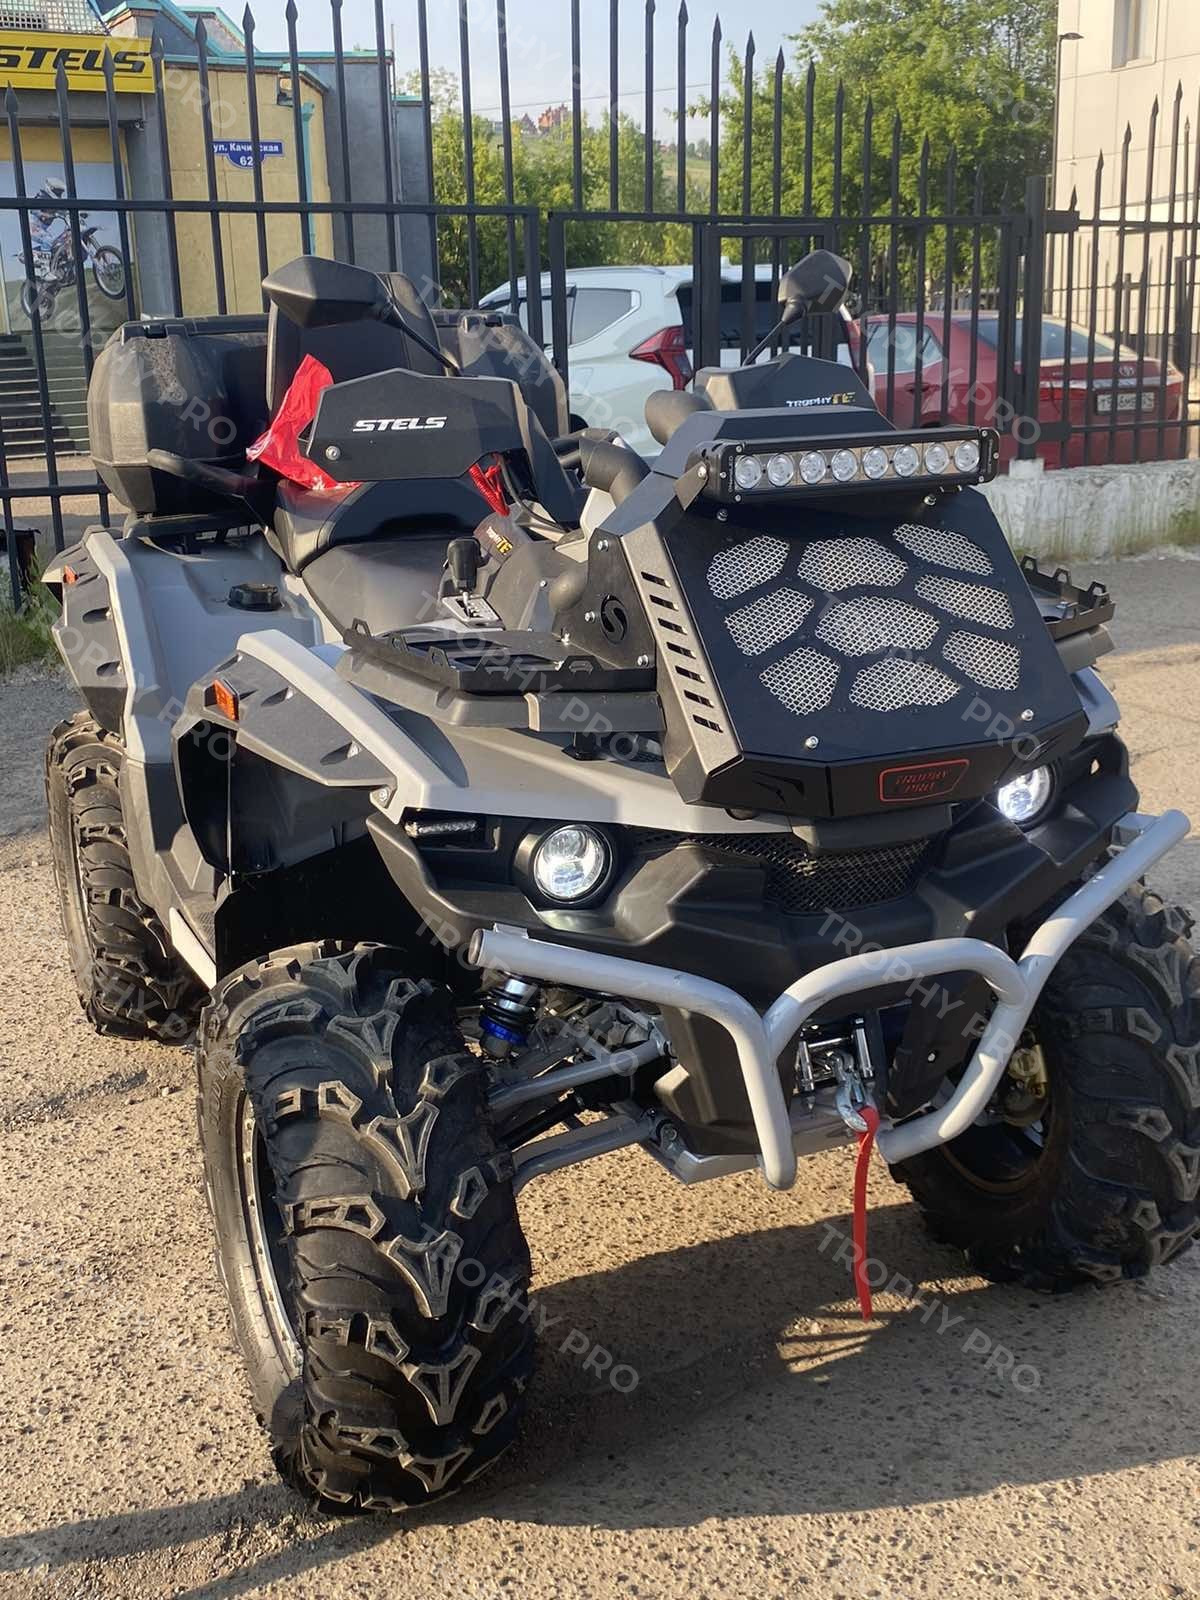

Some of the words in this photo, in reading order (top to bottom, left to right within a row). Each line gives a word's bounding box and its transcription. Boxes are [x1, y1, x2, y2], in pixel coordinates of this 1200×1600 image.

[0, 46, 150, 73] STELS
[213, 143, 227, 153] ул.
[229, 143, 279, 152] Качиская
[352, 416, 447, 432] STELS
